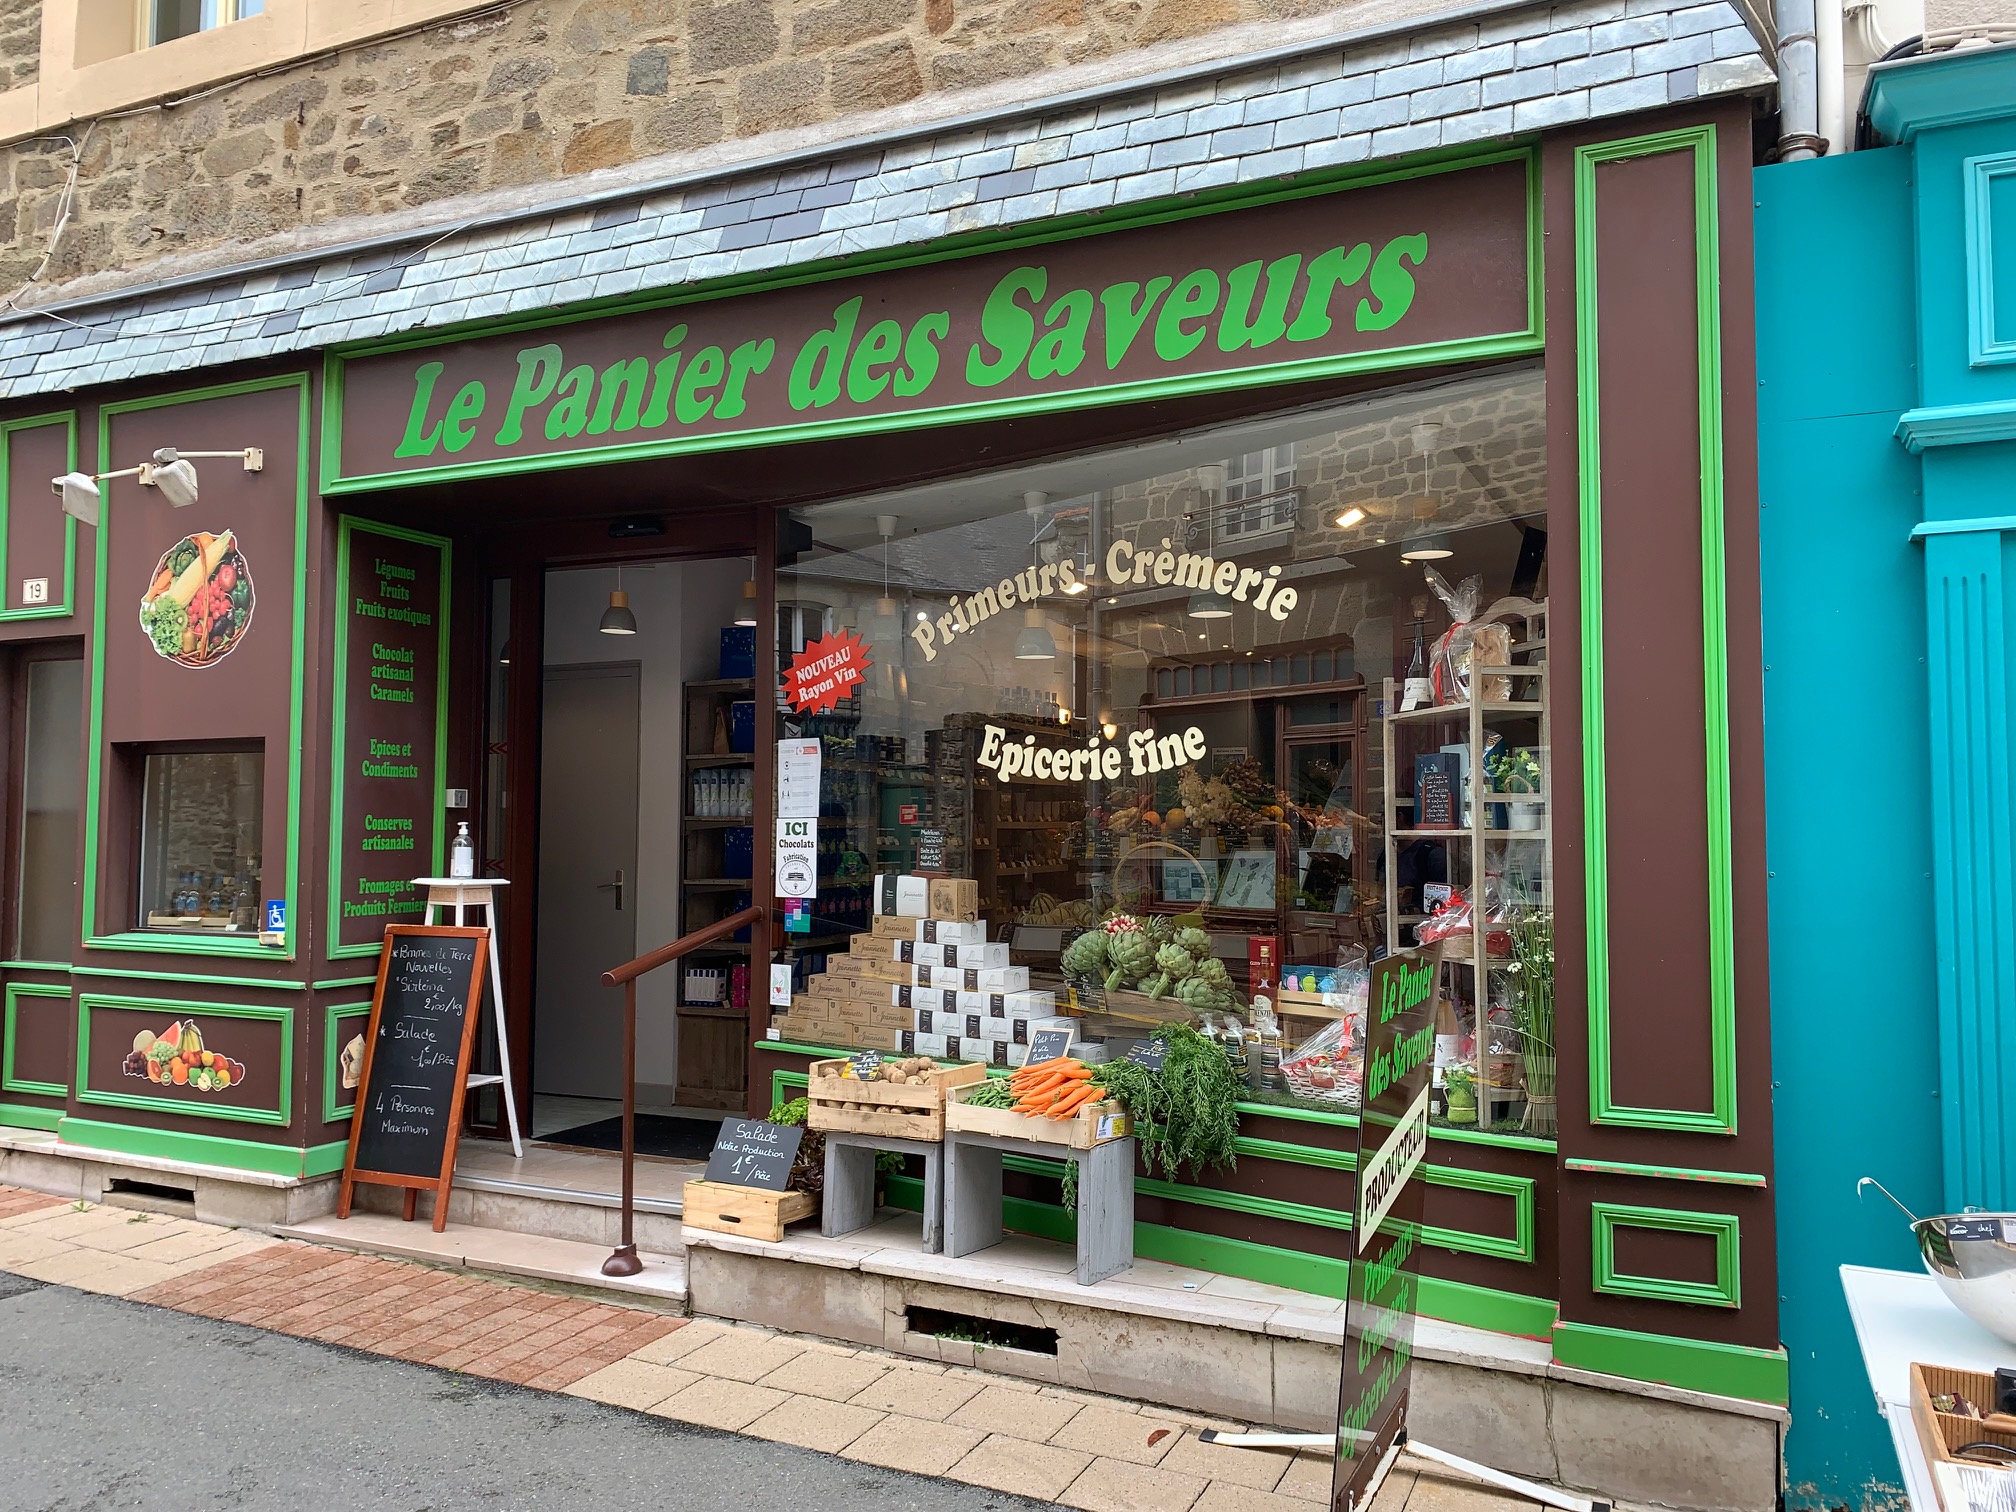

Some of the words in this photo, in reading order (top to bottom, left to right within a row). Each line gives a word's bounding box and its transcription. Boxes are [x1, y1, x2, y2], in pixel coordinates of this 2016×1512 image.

[394, 361, 486, 459] Le
[494, 323, 776, 446] Panier
[787, 296, 949, 411] des
[965, 232, 1428, 387] Saveurs
[375, 558, 415, 580] Légumes
[30, 583, 41, 599] 19
[380, 581, 410, 601] Fruits
[911, 557, 1076, 662] Primeurs
[1105, 537, 1298, 621] Crèmerie
[355, 598, 386, 619] Fruits
[388, 607, 431, 626] exotiques
[372, 643, 414, 663] Chocolat
[371, 664, 414, 681] artisanal
[796, 646, 851, 685] NOUVEAU
[370, 683, 414, 703] Caramels
[798, 678, 834, 702] Rayon
[834, 667, 857, 684] Vin
[370, 738, 400, 758] Epices
[402, 743, 411, 756] et
[977, 724, 1122, 782] Epicerie
[1128, 726, 1207, 778] fine
[362, 760, 418, 778] Condiments
[365, 814, 413, 831] Conserves
[785, 822, 808, 836] ICI
[362, 834, 414, 850] artisanales
[779, 839, 814, 848] Chocolats
[783, 852, 809, 863] Fabrication
[359, 878, 405, 896] Fromages
[344, 900, 386, 917] Produits
[881, 921, 911, 934] Jeannette
[450, 947, 473, 960] Terre
[858, 943, 888, 955] Jeannette
[1380, 970, 1397, 1024] Le
[1397, 956, 1434, 1015] Panier
[394, 1022, 438, 1043] Salade
[1369, 1045, 1391, 1101] des
[1392, 1022, 1435, 1083] Saveurs
[376, 1092, 384, 1114] 4
[390, 1095, 435, 1115] Personnes
[381, 1119, 428, 1136] Maximum
[736, 1123, 778, 1143] Salade
[717, 1141, 739, 1152] Notre
[742, 1144, 785, 1159] Production
[1364, 1108, 1425, 1227] PRODUCTEUR
[1362, 1222, 1414, 1311] Primeurs
